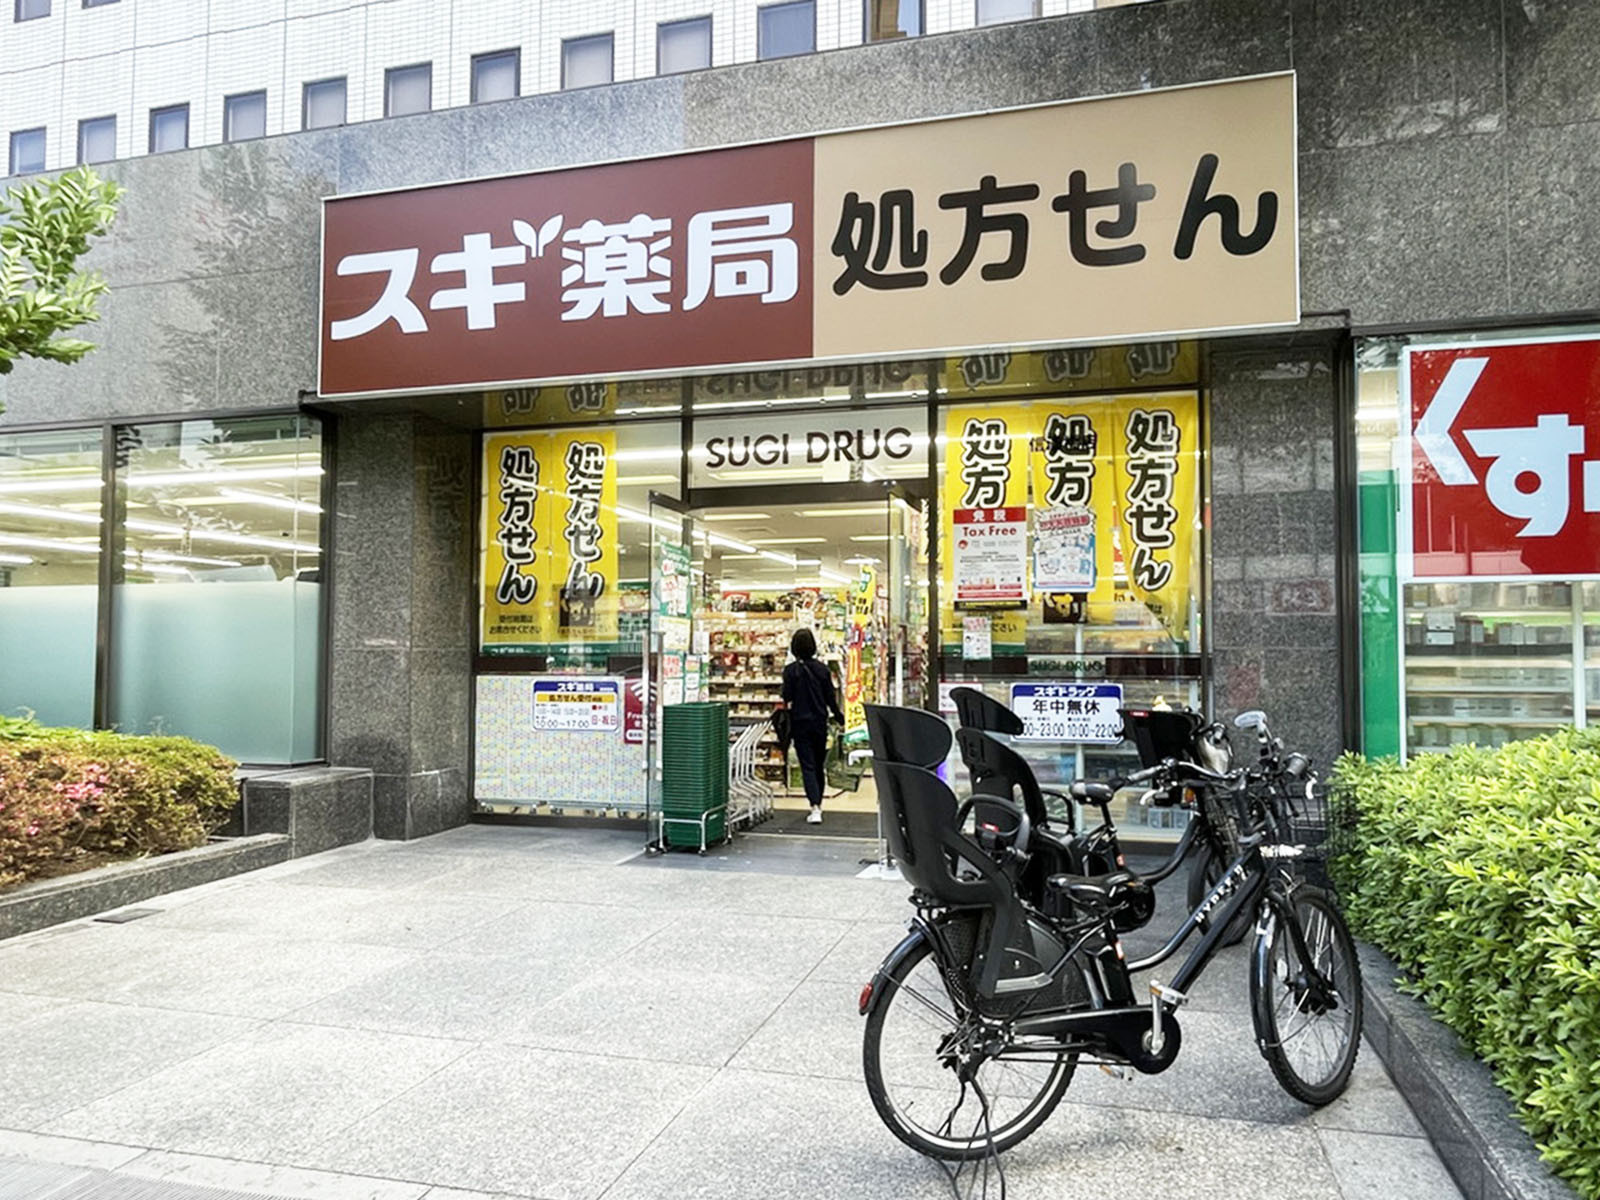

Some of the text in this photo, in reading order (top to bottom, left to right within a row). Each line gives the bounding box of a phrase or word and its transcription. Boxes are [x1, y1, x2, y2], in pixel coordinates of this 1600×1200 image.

[330, 201, 799, 342] スギ薬局
[830, 152, 1279, 297] 処方せん
[705, 426, 913, 469] SUGI DRUG
[1125, 408, 1180, 592] 処方せん
[1413, 356, 1600, 538] くす
[498, 446, 539, 604] 処方せん
[564, 441, 605, 600] 処方せん
[988, 525, 1017, 536] Free
[1032, 699, 1101, 715] 年中無休
[1033, 686, 1099, 697] スギドラッグ
